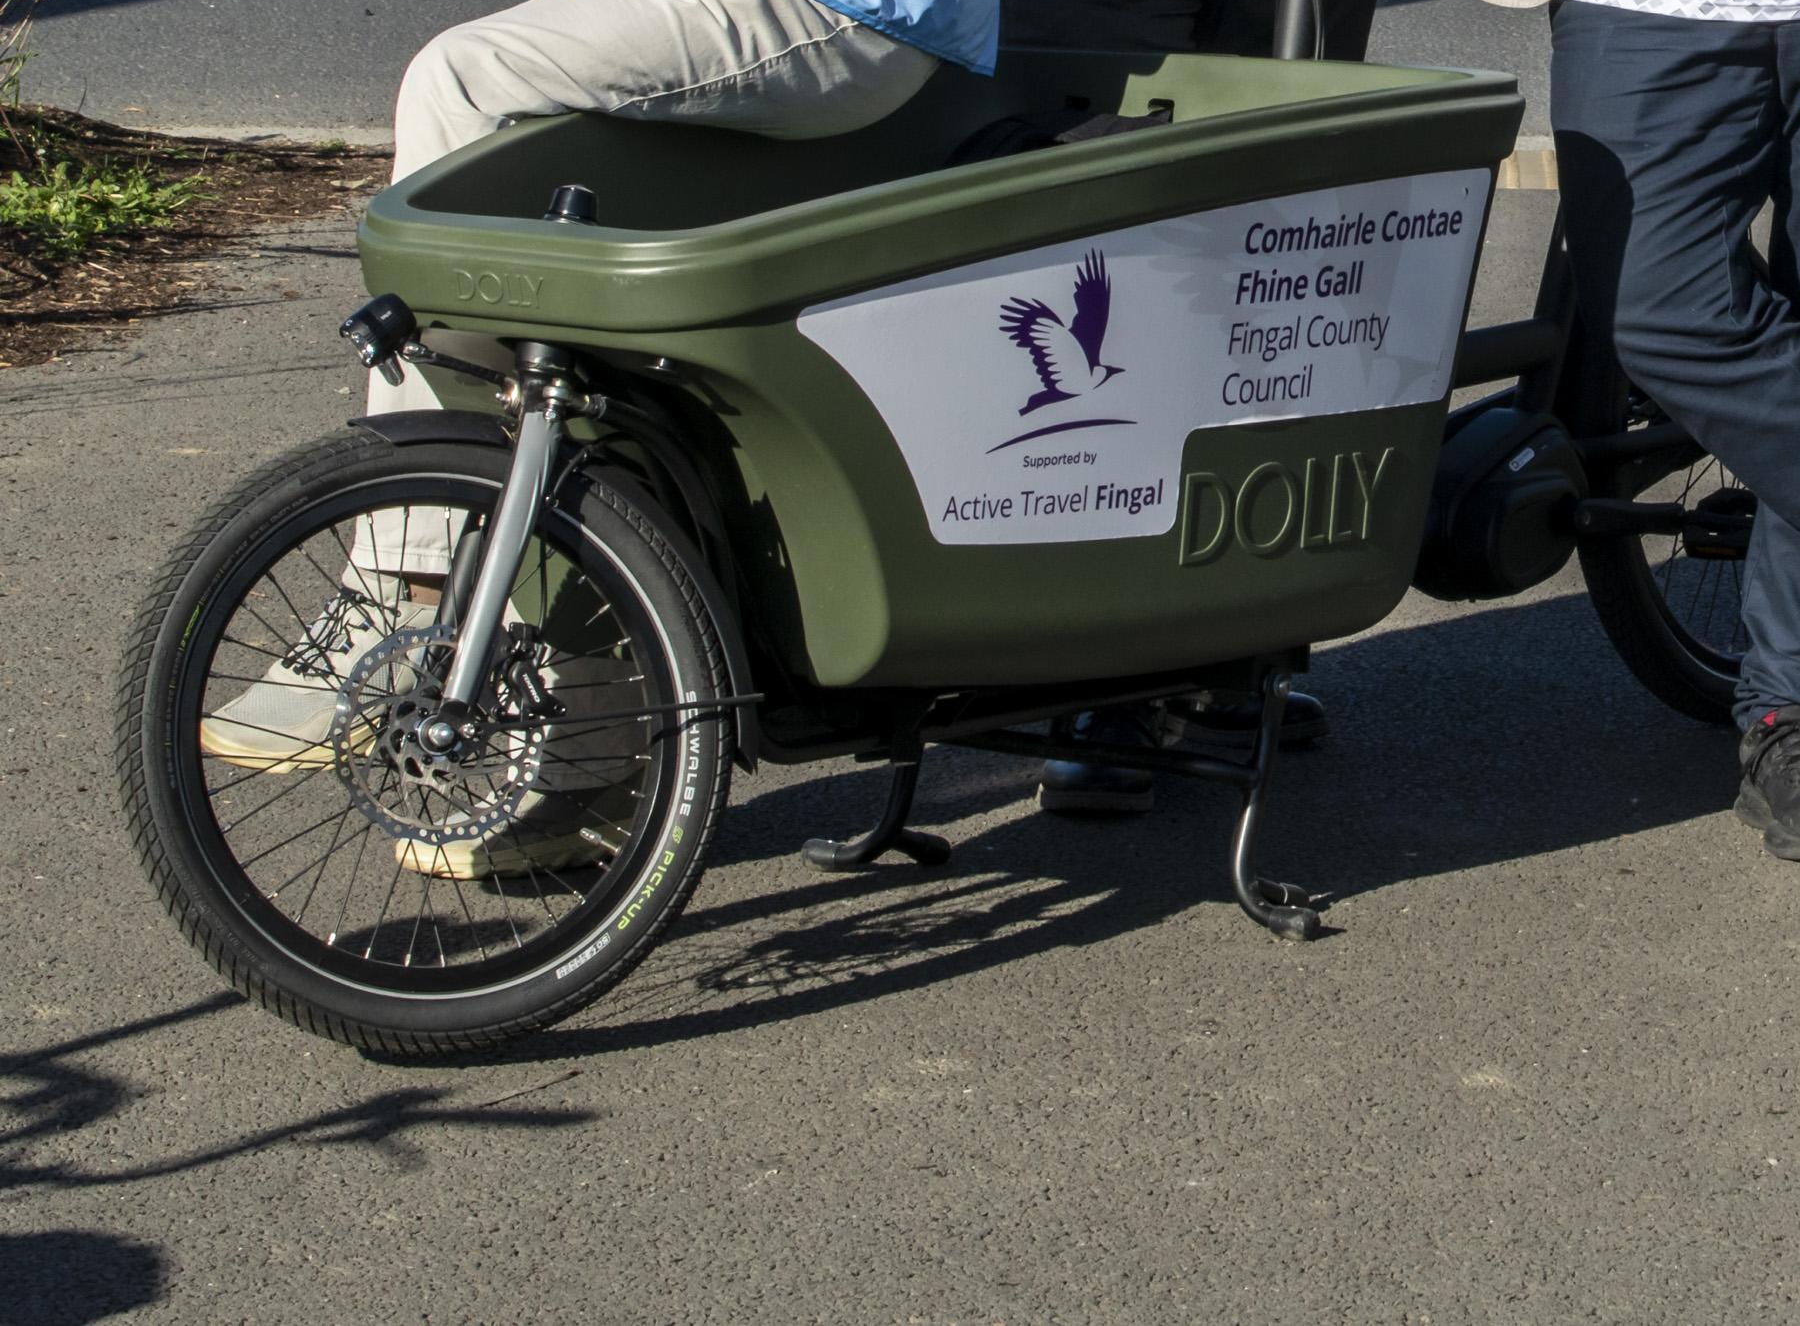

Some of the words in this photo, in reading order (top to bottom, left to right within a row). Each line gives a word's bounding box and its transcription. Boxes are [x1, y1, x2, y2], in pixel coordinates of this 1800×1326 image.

[1245, 213, 1376, 255] Comhairle
[1382, 208, 1462, 242] Contae
[452, 267, 544, 310] DOLLY
[1235, 268, 1308, 306] Fhine
[1315, 260, 1364, 298] Gall
[1228, 315, 1302, 362] Fingal
[1306, 312, 1390, 351] County
[1222, 363, 1313, 406] Council
[1022, 452, 1081, 469] Supported
[1083, 451, 1097, 465] by
[942, 493, 1013, 522] Active
[1020, 484, 1088, 517] Travel
[1095, 478, 1164, 515] Fingal
[1178, 447, 1395, 566] DOLLY
[679, 690, 700, 817] SCHWALBE
[617, 850, 675, 930] PICK-UP
